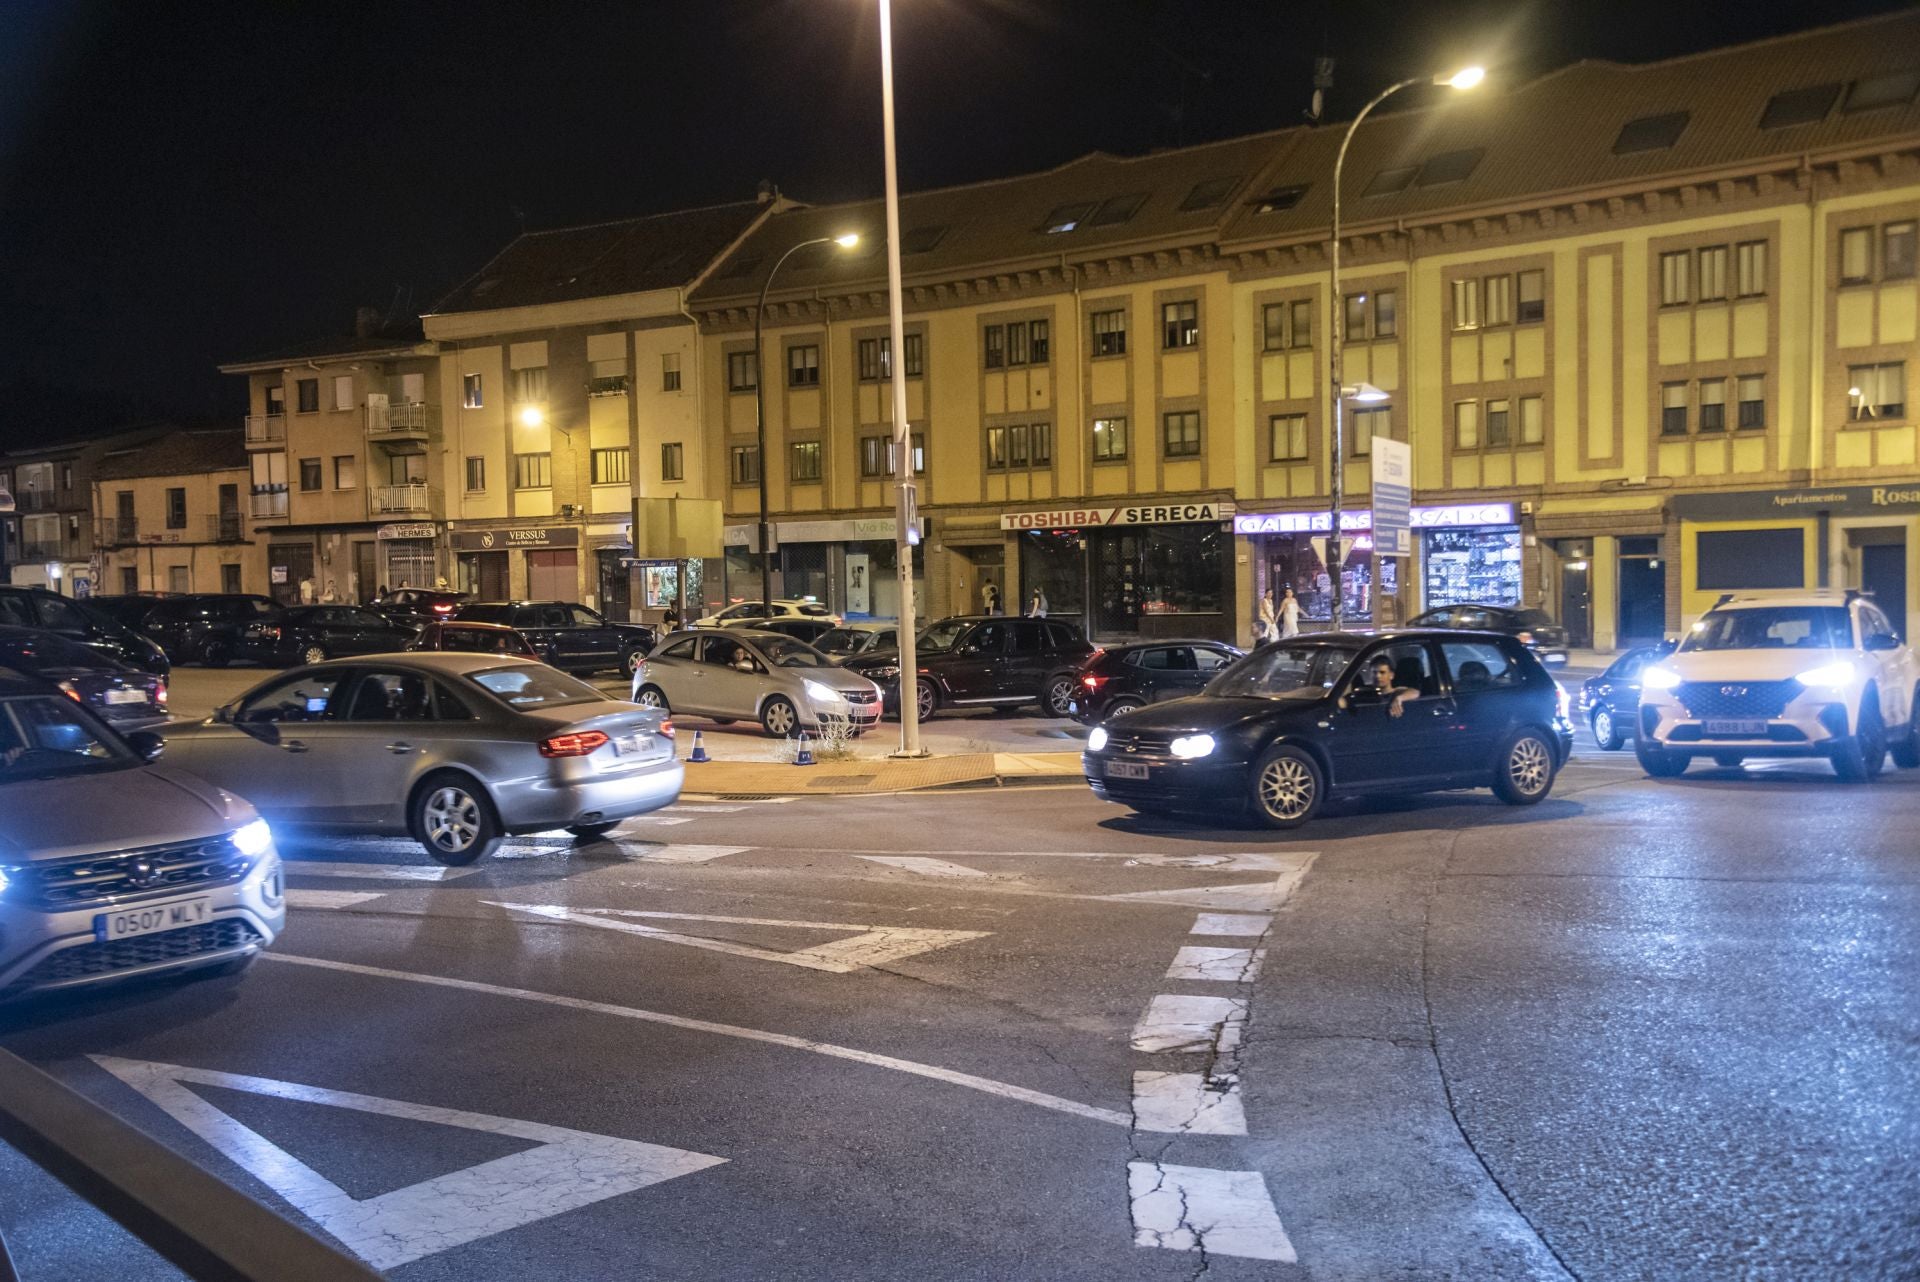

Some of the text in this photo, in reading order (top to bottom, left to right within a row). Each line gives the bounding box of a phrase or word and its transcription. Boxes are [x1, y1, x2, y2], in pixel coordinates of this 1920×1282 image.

[1772, 493, 1848, 507] Apartamentos
[1005, 510, 1103, 529] TOSHIBA
[1126, 504, 1214, 523] SERECA
[1240, 513, 1372, 532] GALERAS
[398, 530, 432, 538] HERMES
[509, 530, 546, 540] VERSSUS
[115, 903, 205, 934] 0507 MLY
